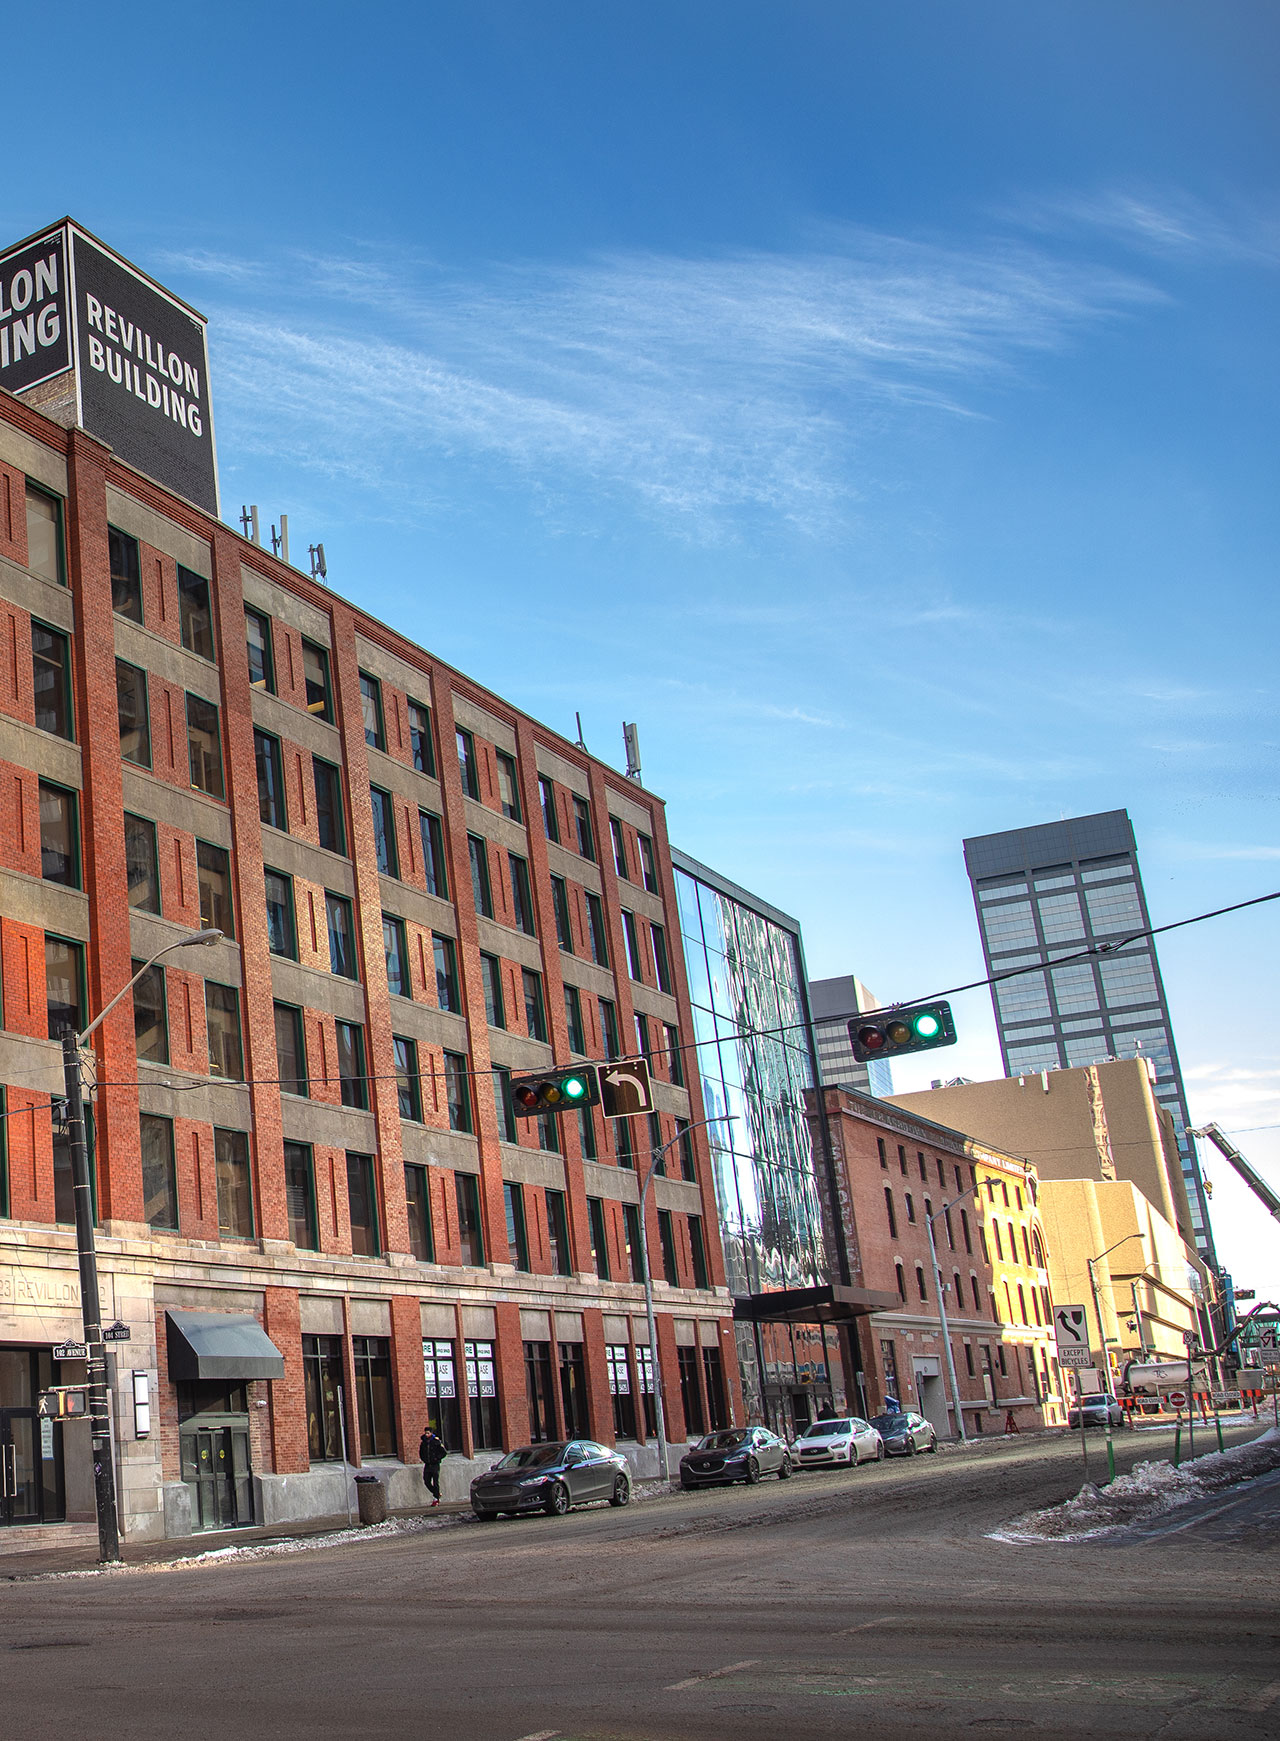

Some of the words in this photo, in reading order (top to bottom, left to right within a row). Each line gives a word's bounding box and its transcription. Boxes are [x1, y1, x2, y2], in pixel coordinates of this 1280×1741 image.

[86, 292, 200, 399] REVILLON
[88, 334, 203, 437] BUILDING
[18, 1281, 79, 1302] REVILLON
[56, 1348, 65, 1357] 102
[66, 1348, 86, 1357] AVENUE
[1063, 1349, 1084, 1357] EXCEPT
[431, 1364, 448, 1375] LASE
